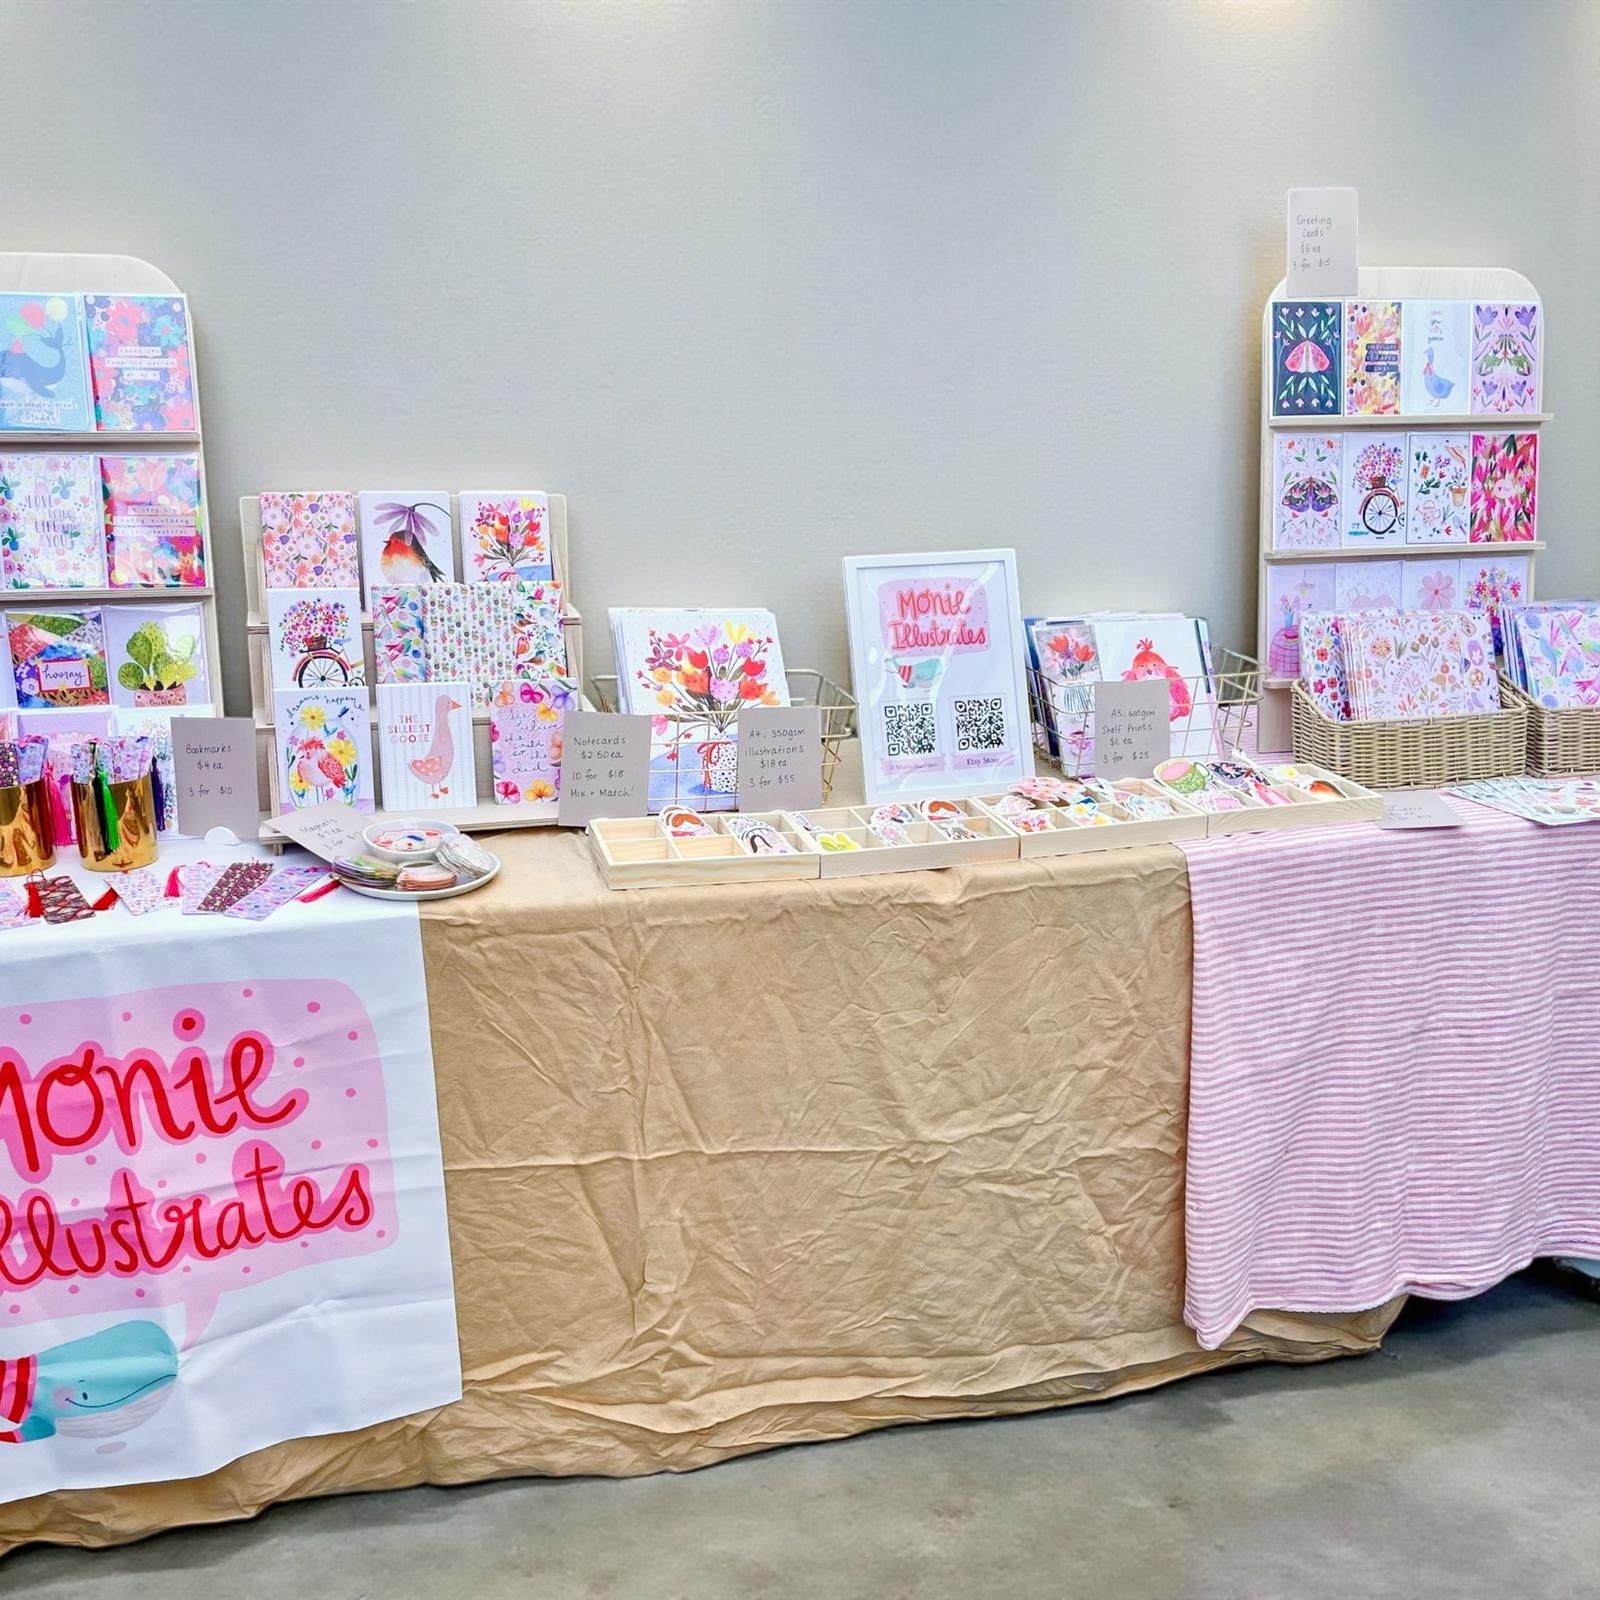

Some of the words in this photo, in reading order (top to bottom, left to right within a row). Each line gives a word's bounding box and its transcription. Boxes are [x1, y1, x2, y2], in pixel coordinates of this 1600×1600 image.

[1296, 214, 1332, 230] Greeting
[1302, 227, 1324, 238] Cards
[1300, 257, 1312, 272] for
[896, 583, 973, 619] Monie
[889, 620, 988, 651] Illustrates
[42, 664, 87, 687] hooray
[286, 694, 320, 719] dreams
[400, 714, 418, 724] THE
[387, 724, 430, 734] SILLIEST
[771, 728, 806, 741] 350gsm
[1102, 724, 1122, 735] Shelf
[1127, 723, 1152, 733] Prints
[390, 733, 430, 743] GOOSE
[573, 736, 627, 746] Notecards
[186, 743, 232, 754] Bookmarks
[760, 758, 776, 769] $18
[778, 760, 787, 768] ea
[966, 758, 981, 767] Etsy
[1103, 753, 1109, 764] 3
[1112, 752, 1124, 764] for
[1132, 751, 1150, 761] $25
[196, 759, 210, 771] $4
[212, 762, 224, 770] ea
[572, 771, 581, 781] 10
[585, 768, 598, 781] for
[749, 777, 755, 788] 3
[759, 776, 772, 790] for
[778, 774, 796, 784] $55
[189, 786, 194, 797] 3
[198, 783, 210, 798] for
[219, 785, 233, 795] $10
[570, 788, 586, 798] Mix
[0, 1146, 373, 1286] llustrates
